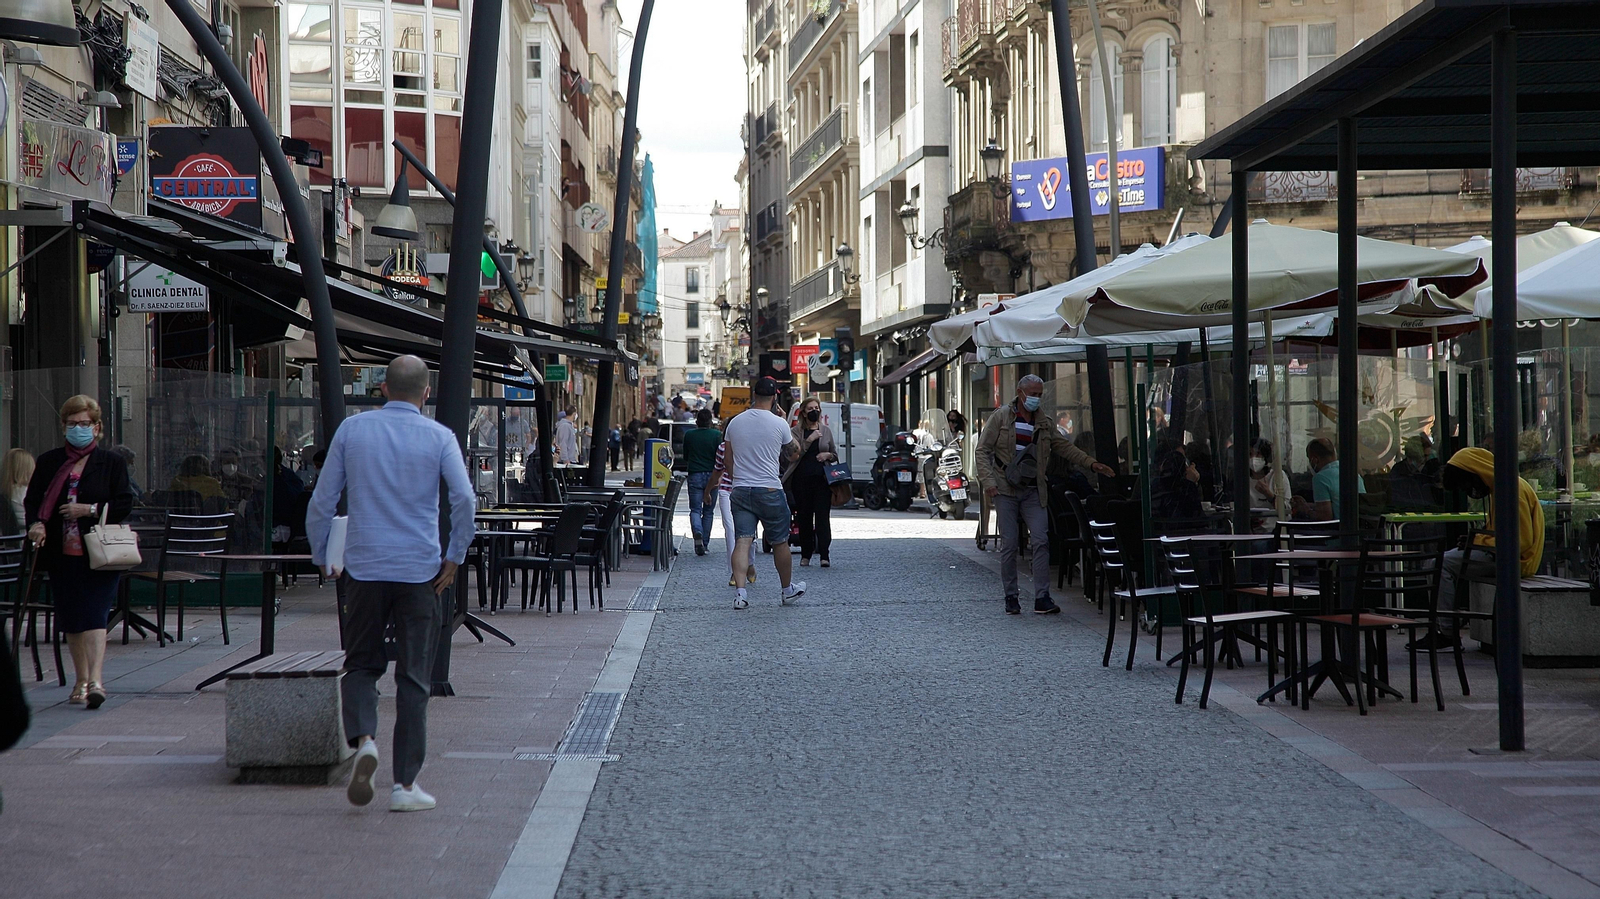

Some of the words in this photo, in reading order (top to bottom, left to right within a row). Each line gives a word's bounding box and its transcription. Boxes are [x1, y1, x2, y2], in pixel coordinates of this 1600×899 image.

[196, 164, 214, 173] CAFÉ
[1122, 177, 1145, 187] Empresas
[160, 180, 250, 196] CENTRAL
[1117, 188, 1145, 203] sTime
[190, 200, 222, 213] ARÁBICA
[390, 276, 421, 284] BODEGA
[131, 288, 167, 298] CLINICA
[170, 287, 203, 297] DENTAL
[147, 302, 184, 310] SAENZ-DIEZ
